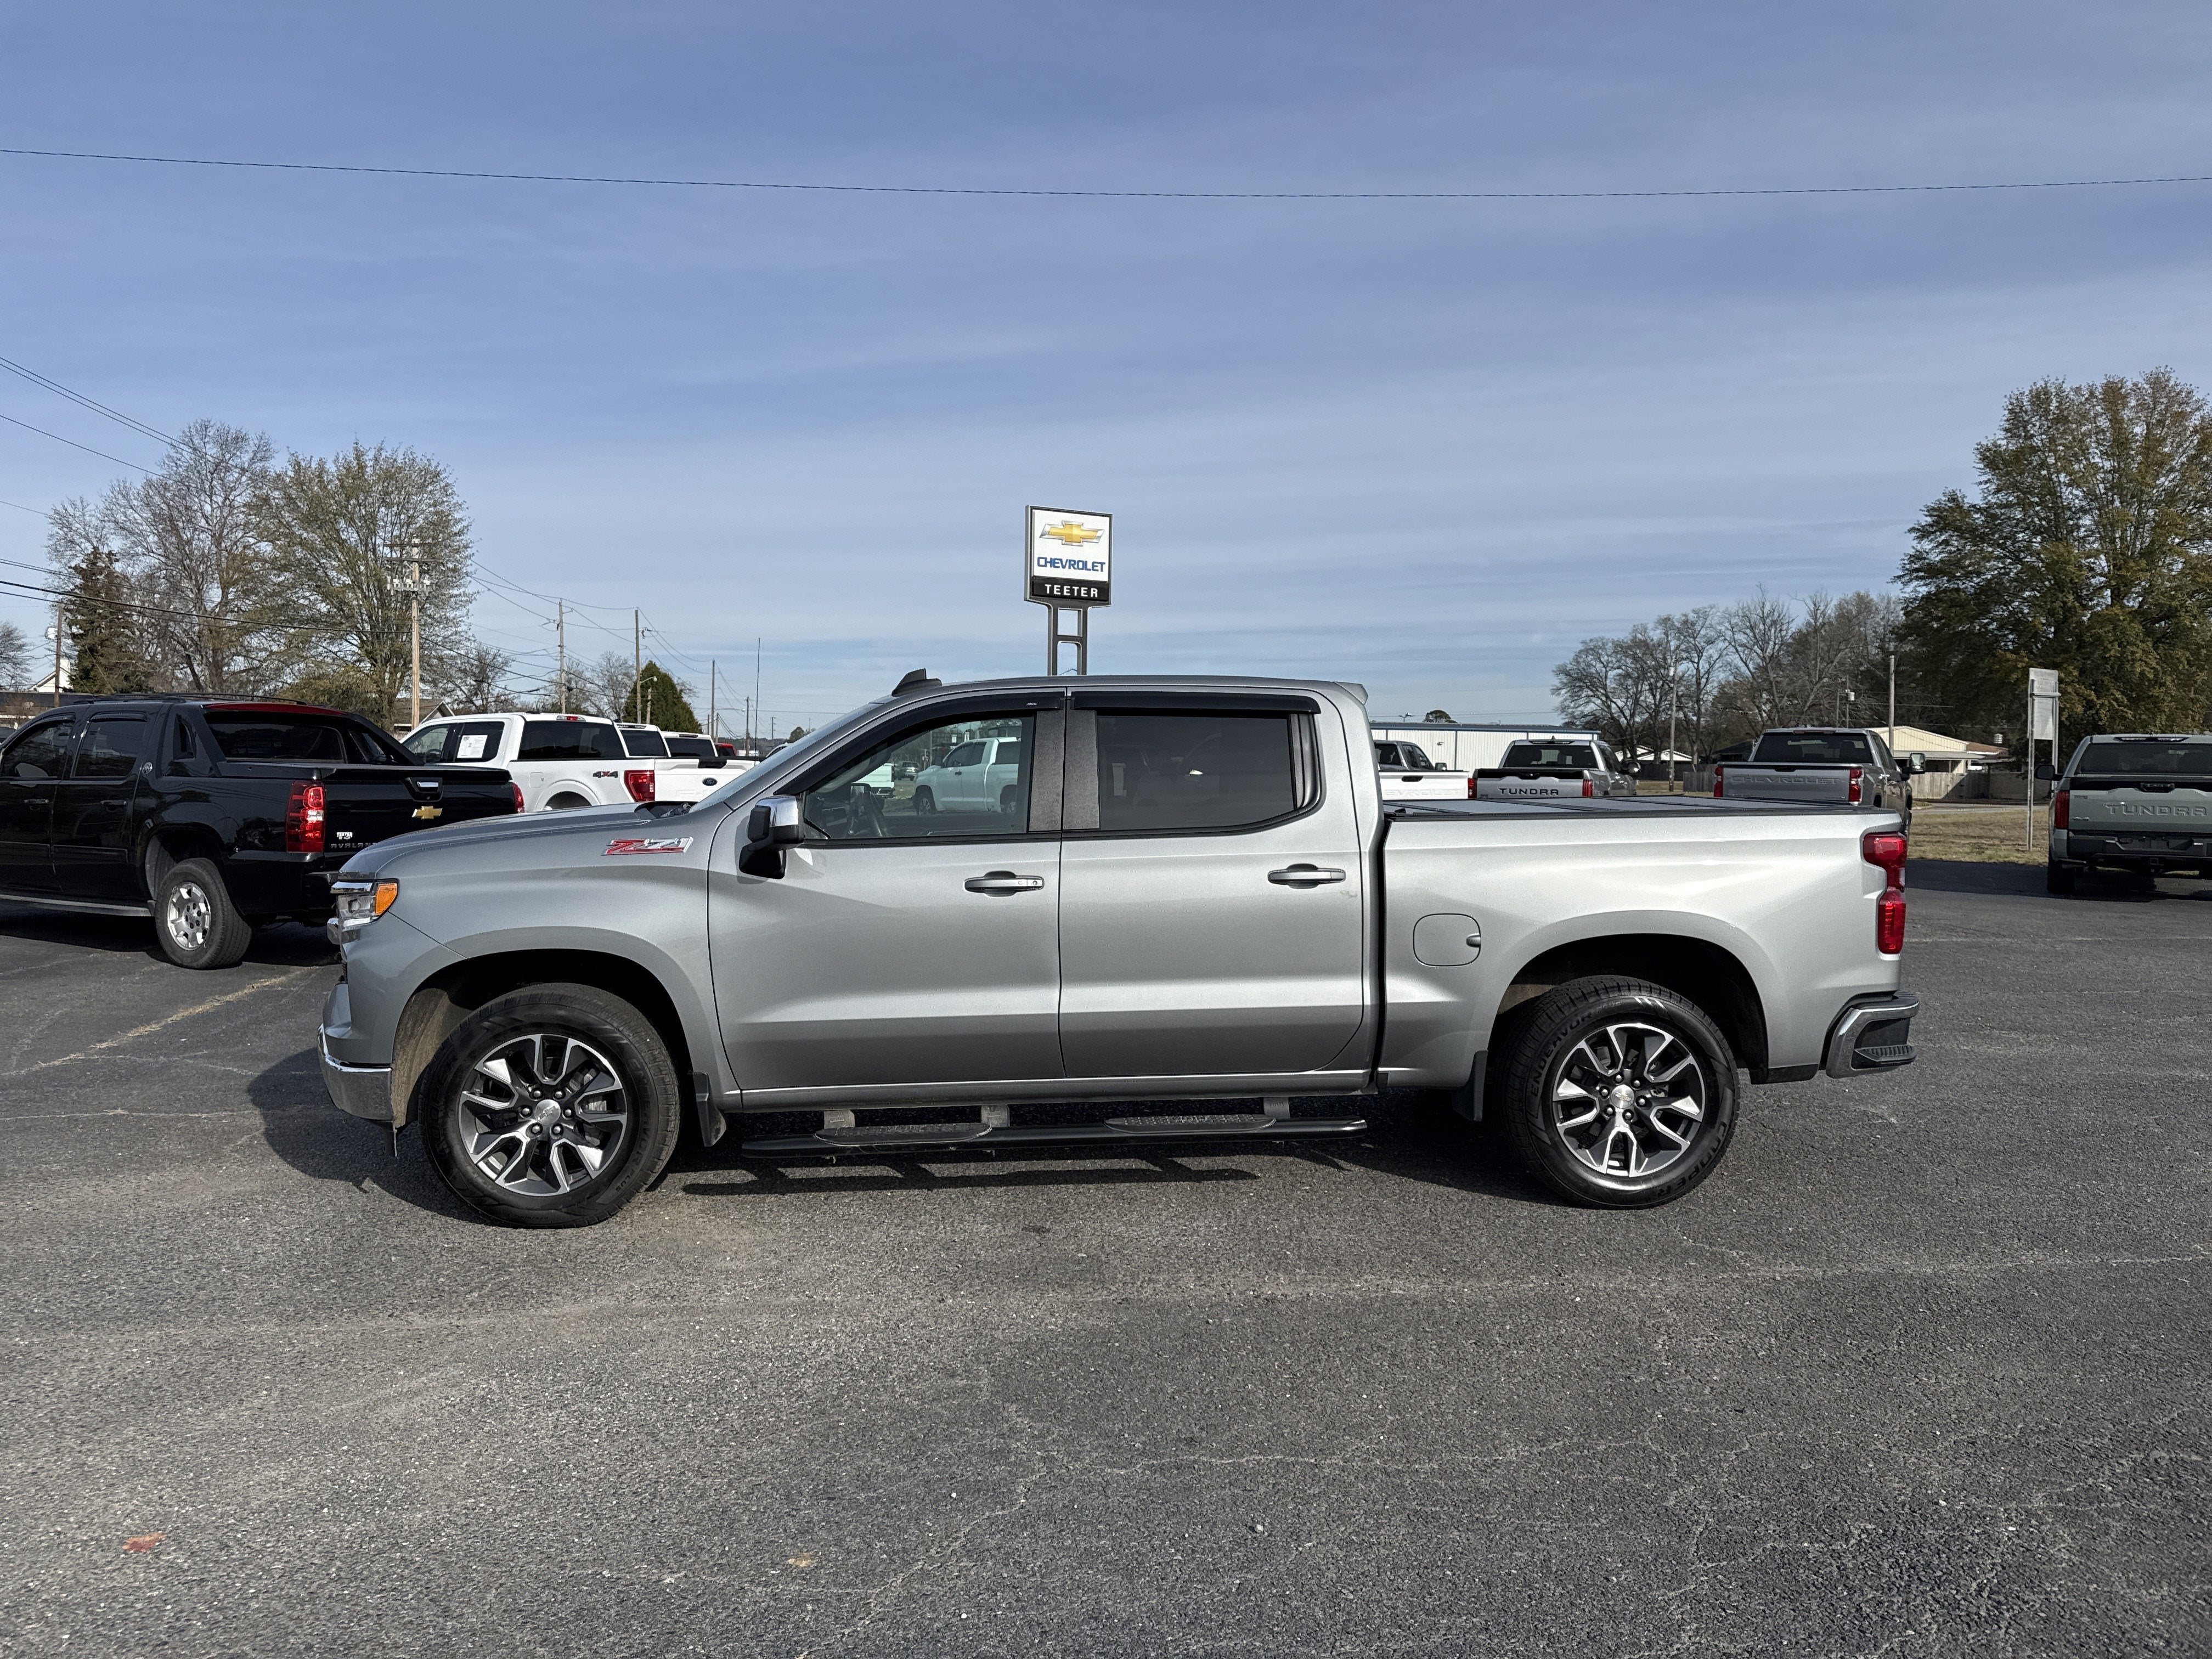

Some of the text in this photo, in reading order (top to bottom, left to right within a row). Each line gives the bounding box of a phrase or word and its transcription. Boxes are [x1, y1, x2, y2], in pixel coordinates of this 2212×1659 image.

[1037, 556, 1106, 572] CHEVROLET
[1044, 584, 1098, 598] TEETER
[1730, 775, 1841, 785] CHEVROLET
[2104, 804, 2207, 817] TUNDRA
[602, 837, 694, 855] Z71
[1530, 1012, 1593, 1097] ENDEAVOR
[1655, 1120, 1728, 1198] COOPER
[614, 1168, 635, 1193] PLUS
